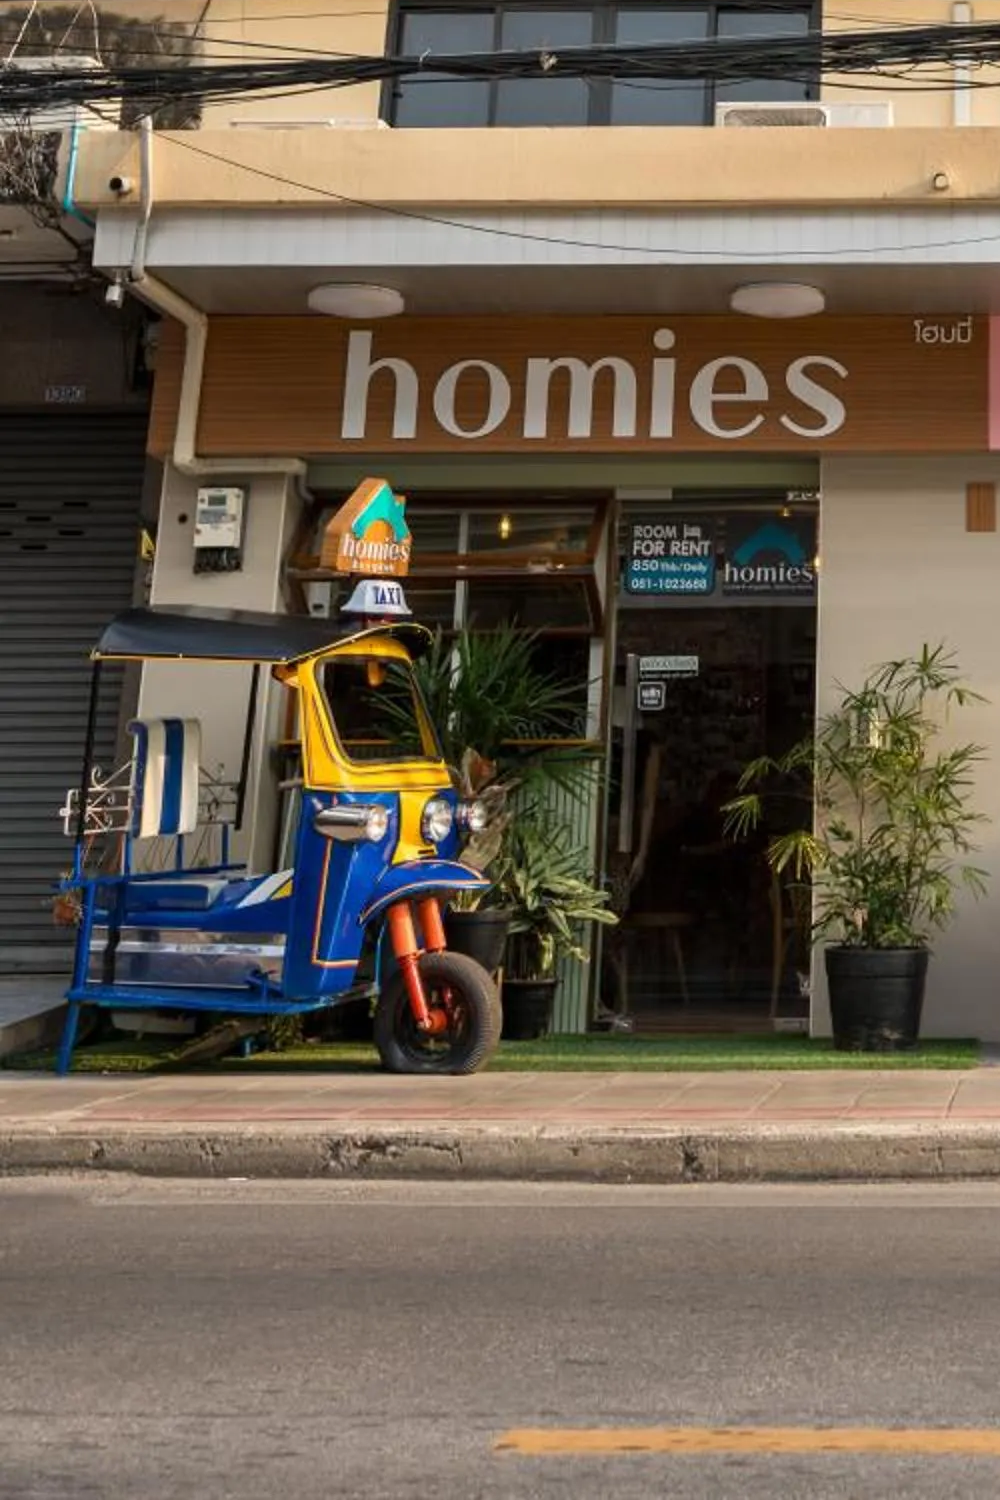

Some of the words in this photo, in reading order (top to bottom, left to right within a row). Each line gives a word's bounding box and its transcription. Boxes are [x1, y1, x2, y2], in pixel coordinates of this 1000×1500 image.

[340, 328, 849, 439] homies
[633, 524, 677, 539] ROOM
[341, 532, 411, 563] homies
[632, 540, 665, 556] FOR
[670, 539, 711, 556] RENT
[631, 559, 659, 571] 850
[724, 562, 813, 583] homies
[373, 586, 401, 605] TAXI
